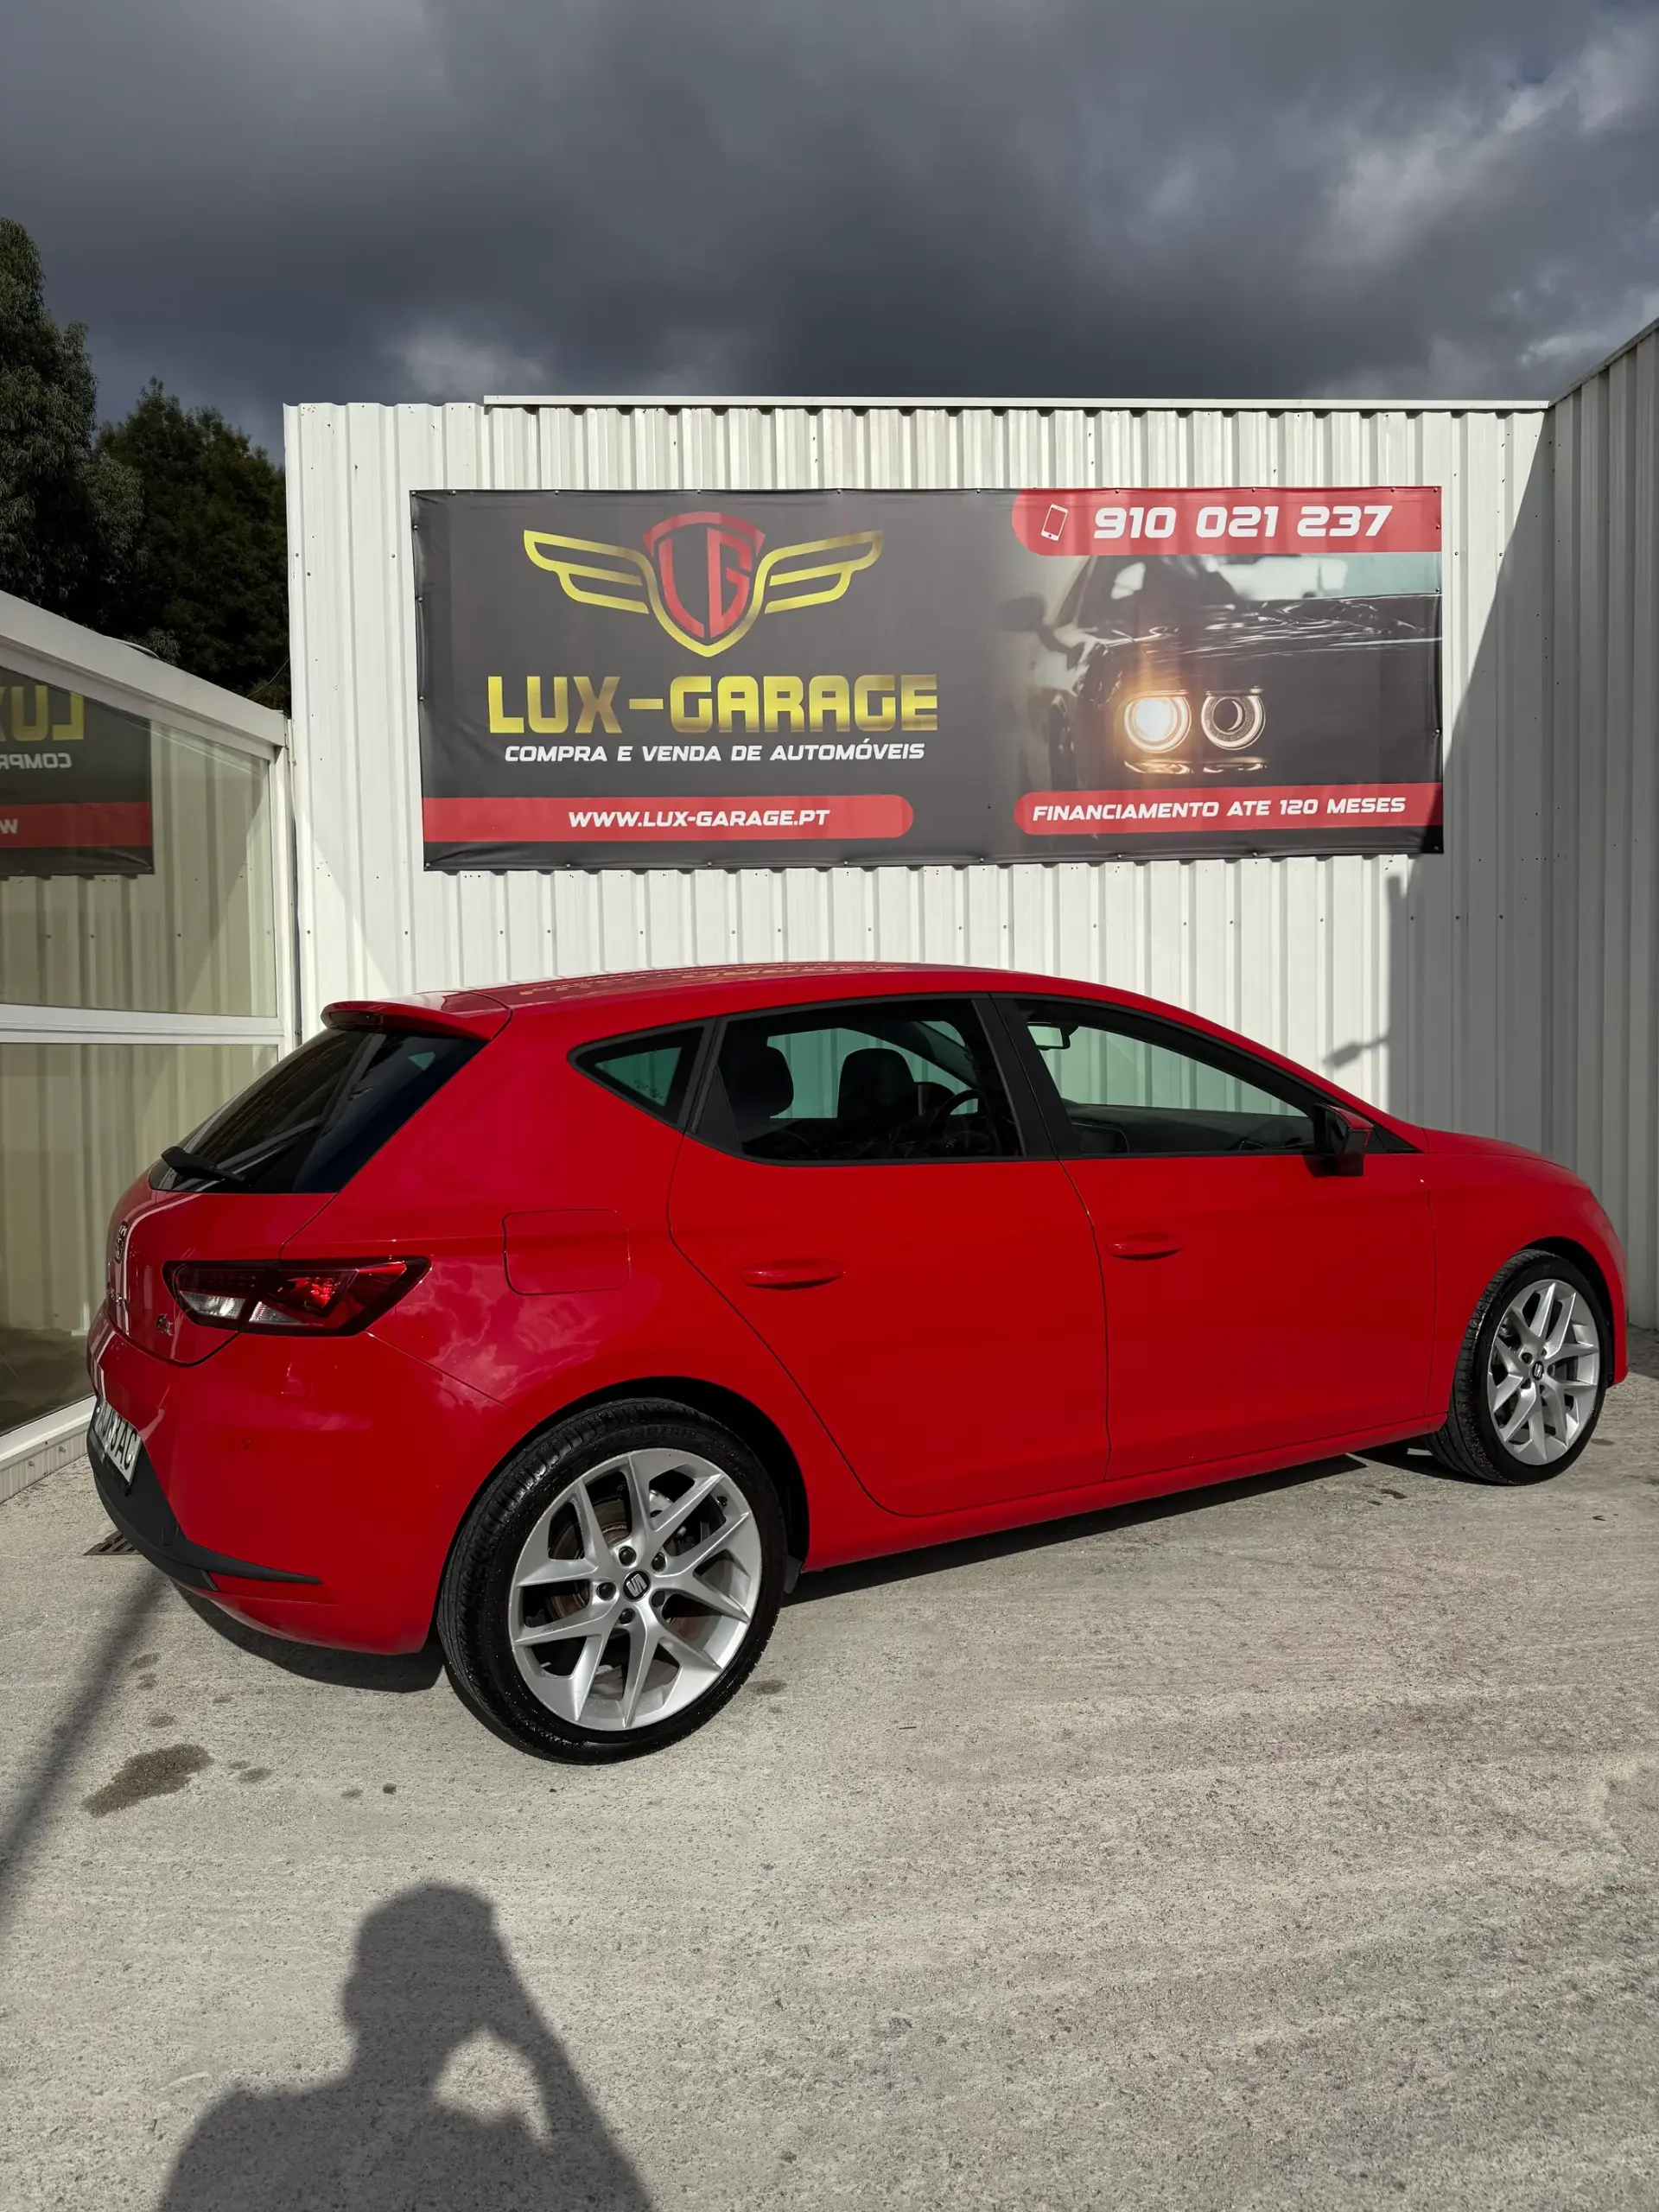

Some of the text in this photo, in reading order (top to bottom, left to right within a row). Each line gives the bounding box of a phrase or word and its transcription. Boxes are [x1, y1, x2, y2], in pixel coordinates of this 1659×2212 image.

[1093, 505, 1393, 539] 910 021 237
[487, 675, 938, 734] LUX-GARAGE
[505, 738, 925, 762] COMPRA E VENDA DE AUTOMÓVEIS
[569, 810, 830, 828] WWW.LUX-GARAGE.PT
[1033, 797, 1406, 822] FINANCIAMENTO ATE 120 MESES
